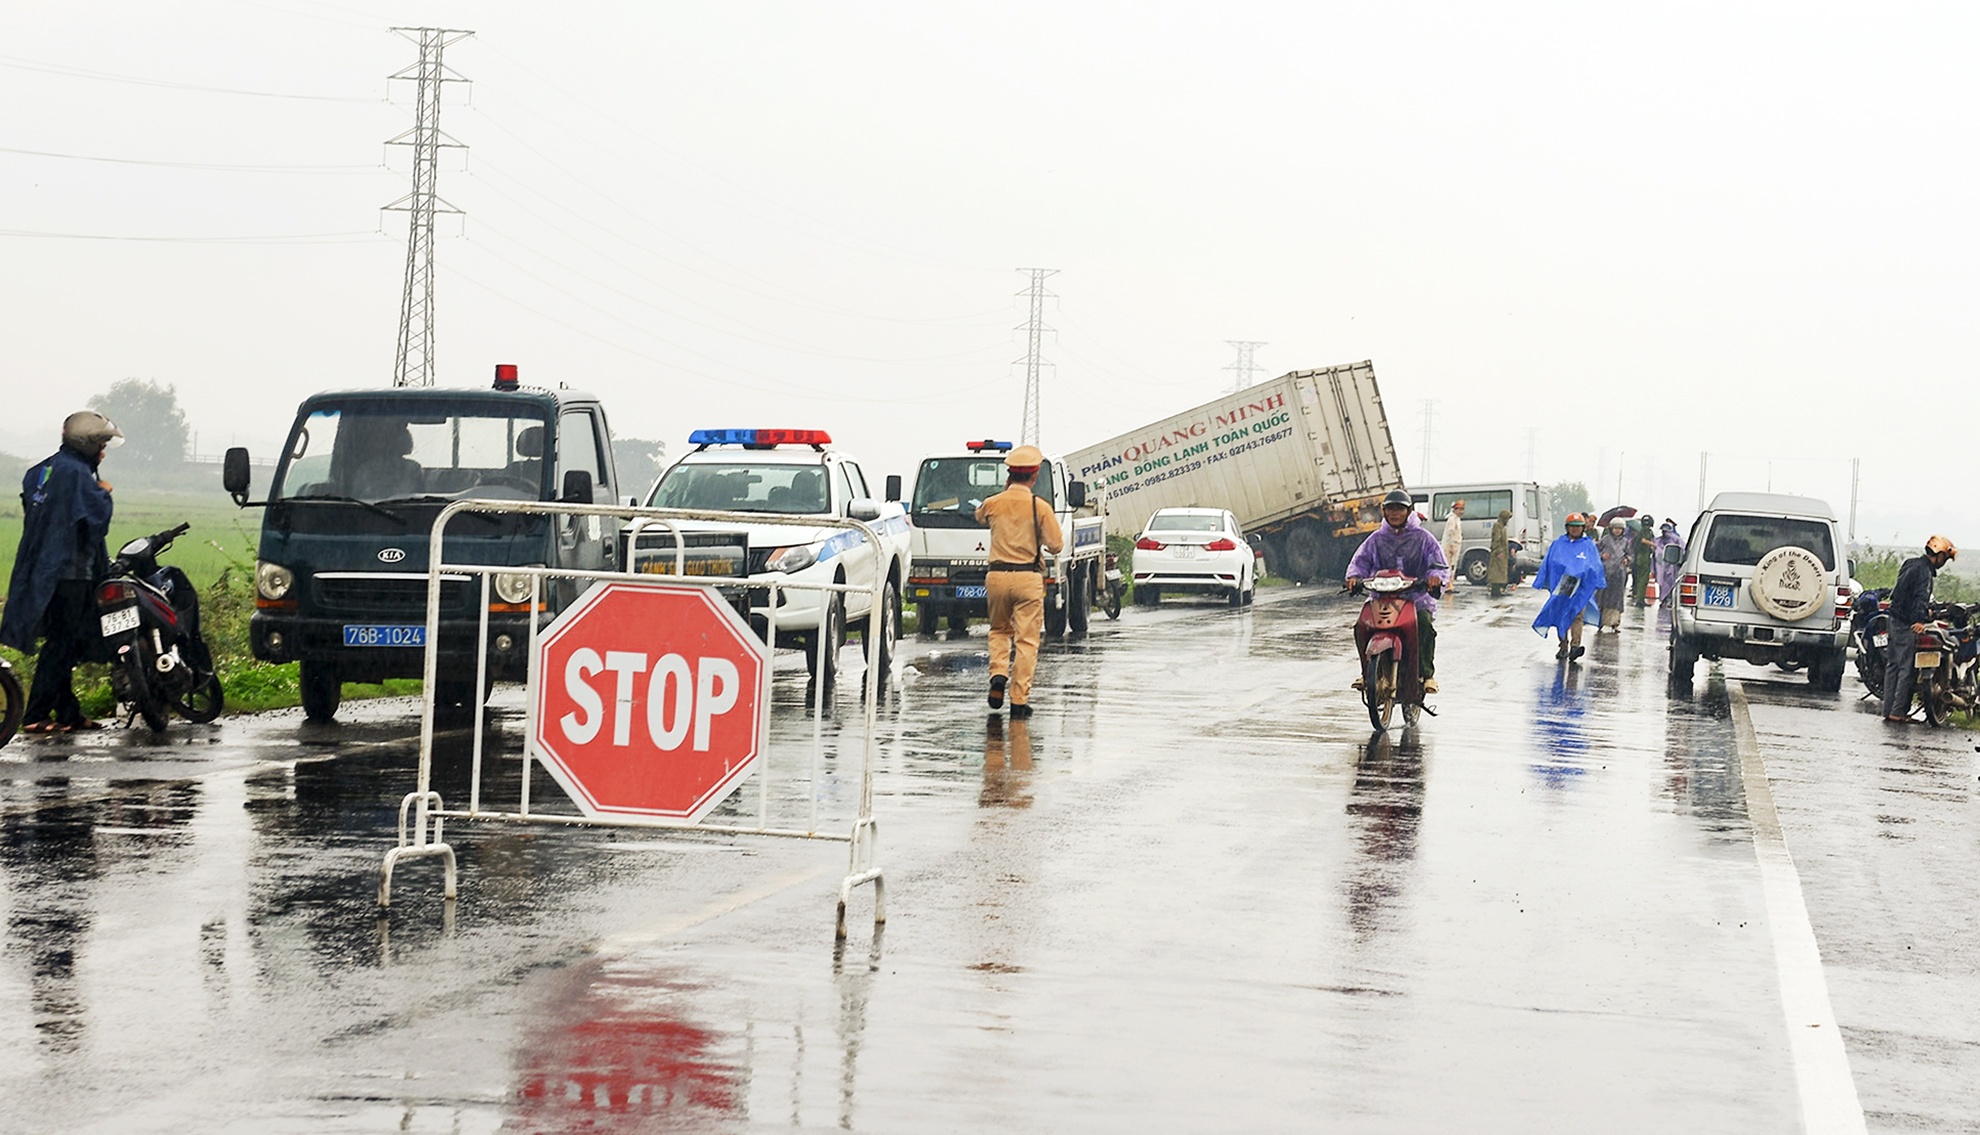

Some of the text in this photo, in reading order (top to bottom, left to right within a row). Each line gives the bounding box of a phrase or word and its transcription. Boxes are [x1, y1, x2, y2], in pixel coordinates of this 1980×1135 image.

[1123, 422, 1206, 461] QUANG
[1216, 392, 1285, 429] MINH
[1174, 441, 1209, 462] LẠNH
[1212, 427, 1249, 447] TOÀN
[1252, 409, 1290, 433] QUỐC
[1207, 451, 1228, 464] FAX:
[382, 551, 401, 560] KIA
[1762, 550, 1822, 578] King of the Desert
[1710, 586, 1729, 597] 76B
[1709, 595, 1731, 607] 1279
[106, 609, 131, 624] 76-B1
[349, 628, 422, 644] 76B-1024
[559, 647, 740, 752] STOP
